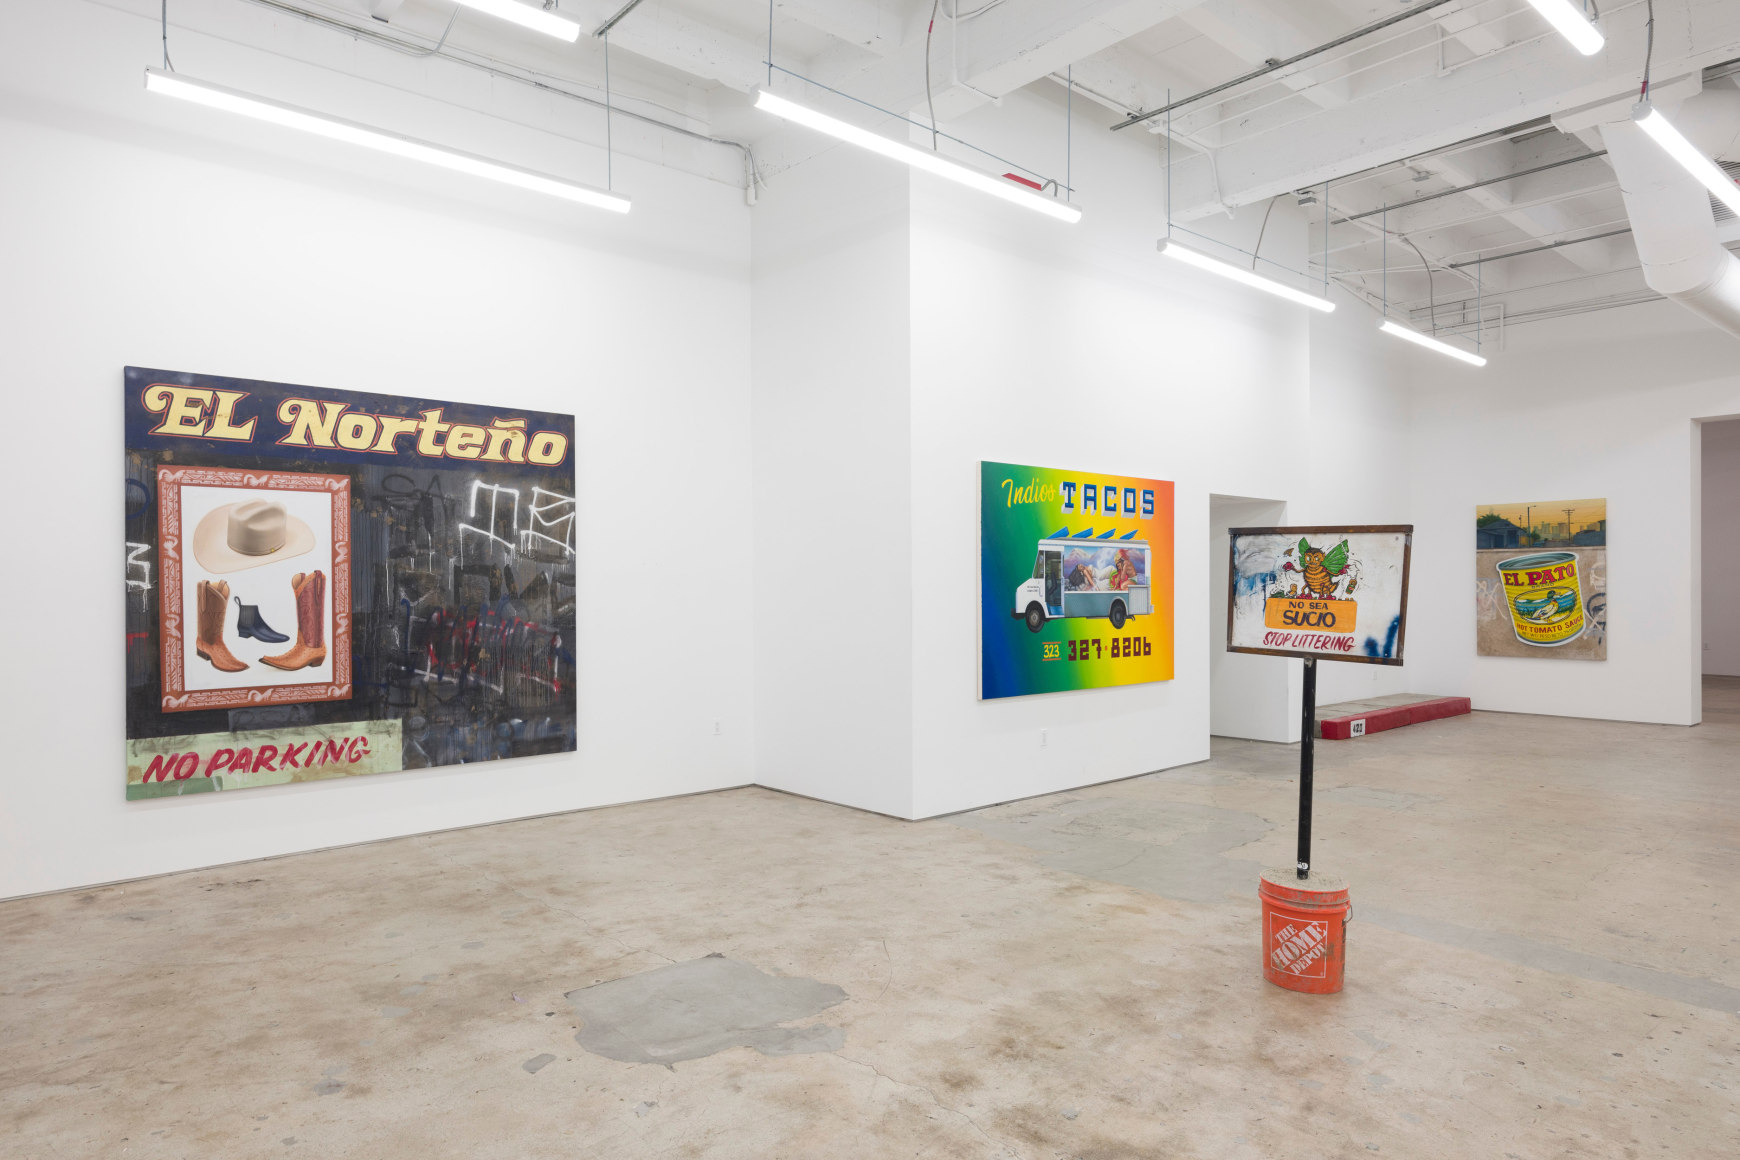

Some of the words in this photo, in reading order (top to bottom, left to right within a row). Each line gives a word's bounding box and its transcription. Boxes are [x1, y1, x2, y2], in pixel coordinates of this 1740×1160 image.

[142, 383, 258, 443] EL
[276, 397, 569, 467] Norteño
[1001, 478, 1056, 508] Indios
[1060, 481, 1154, 520] TACOS
[1503, 573, 1524, 586] EL
[1525, 564, 1575, 586] PATO
[1288, 601, 1305, 610] NO
[1309, 602, 1328, 610] SEA
[1282, 609, 1336, 628] SUCIO
[1516, 623, 1528, 631] HOT
[1529, 625, 1562, 633] TOMATO
[1565, 614, 1584, 628] SAUCE
[1043, 644, 1060, 659] 323
[1263, 631, 1292, 647] STOP
[1292, 634, 1355, 652] LITTERING
[142, 752, 200, 784] NO
[205, 736, 371, 778] PARKING
[1275, 923, 1298, 943] THE
[1271, 921, 1327, 970] HOME
[1289, 942, 1326, 975] DEPOT
